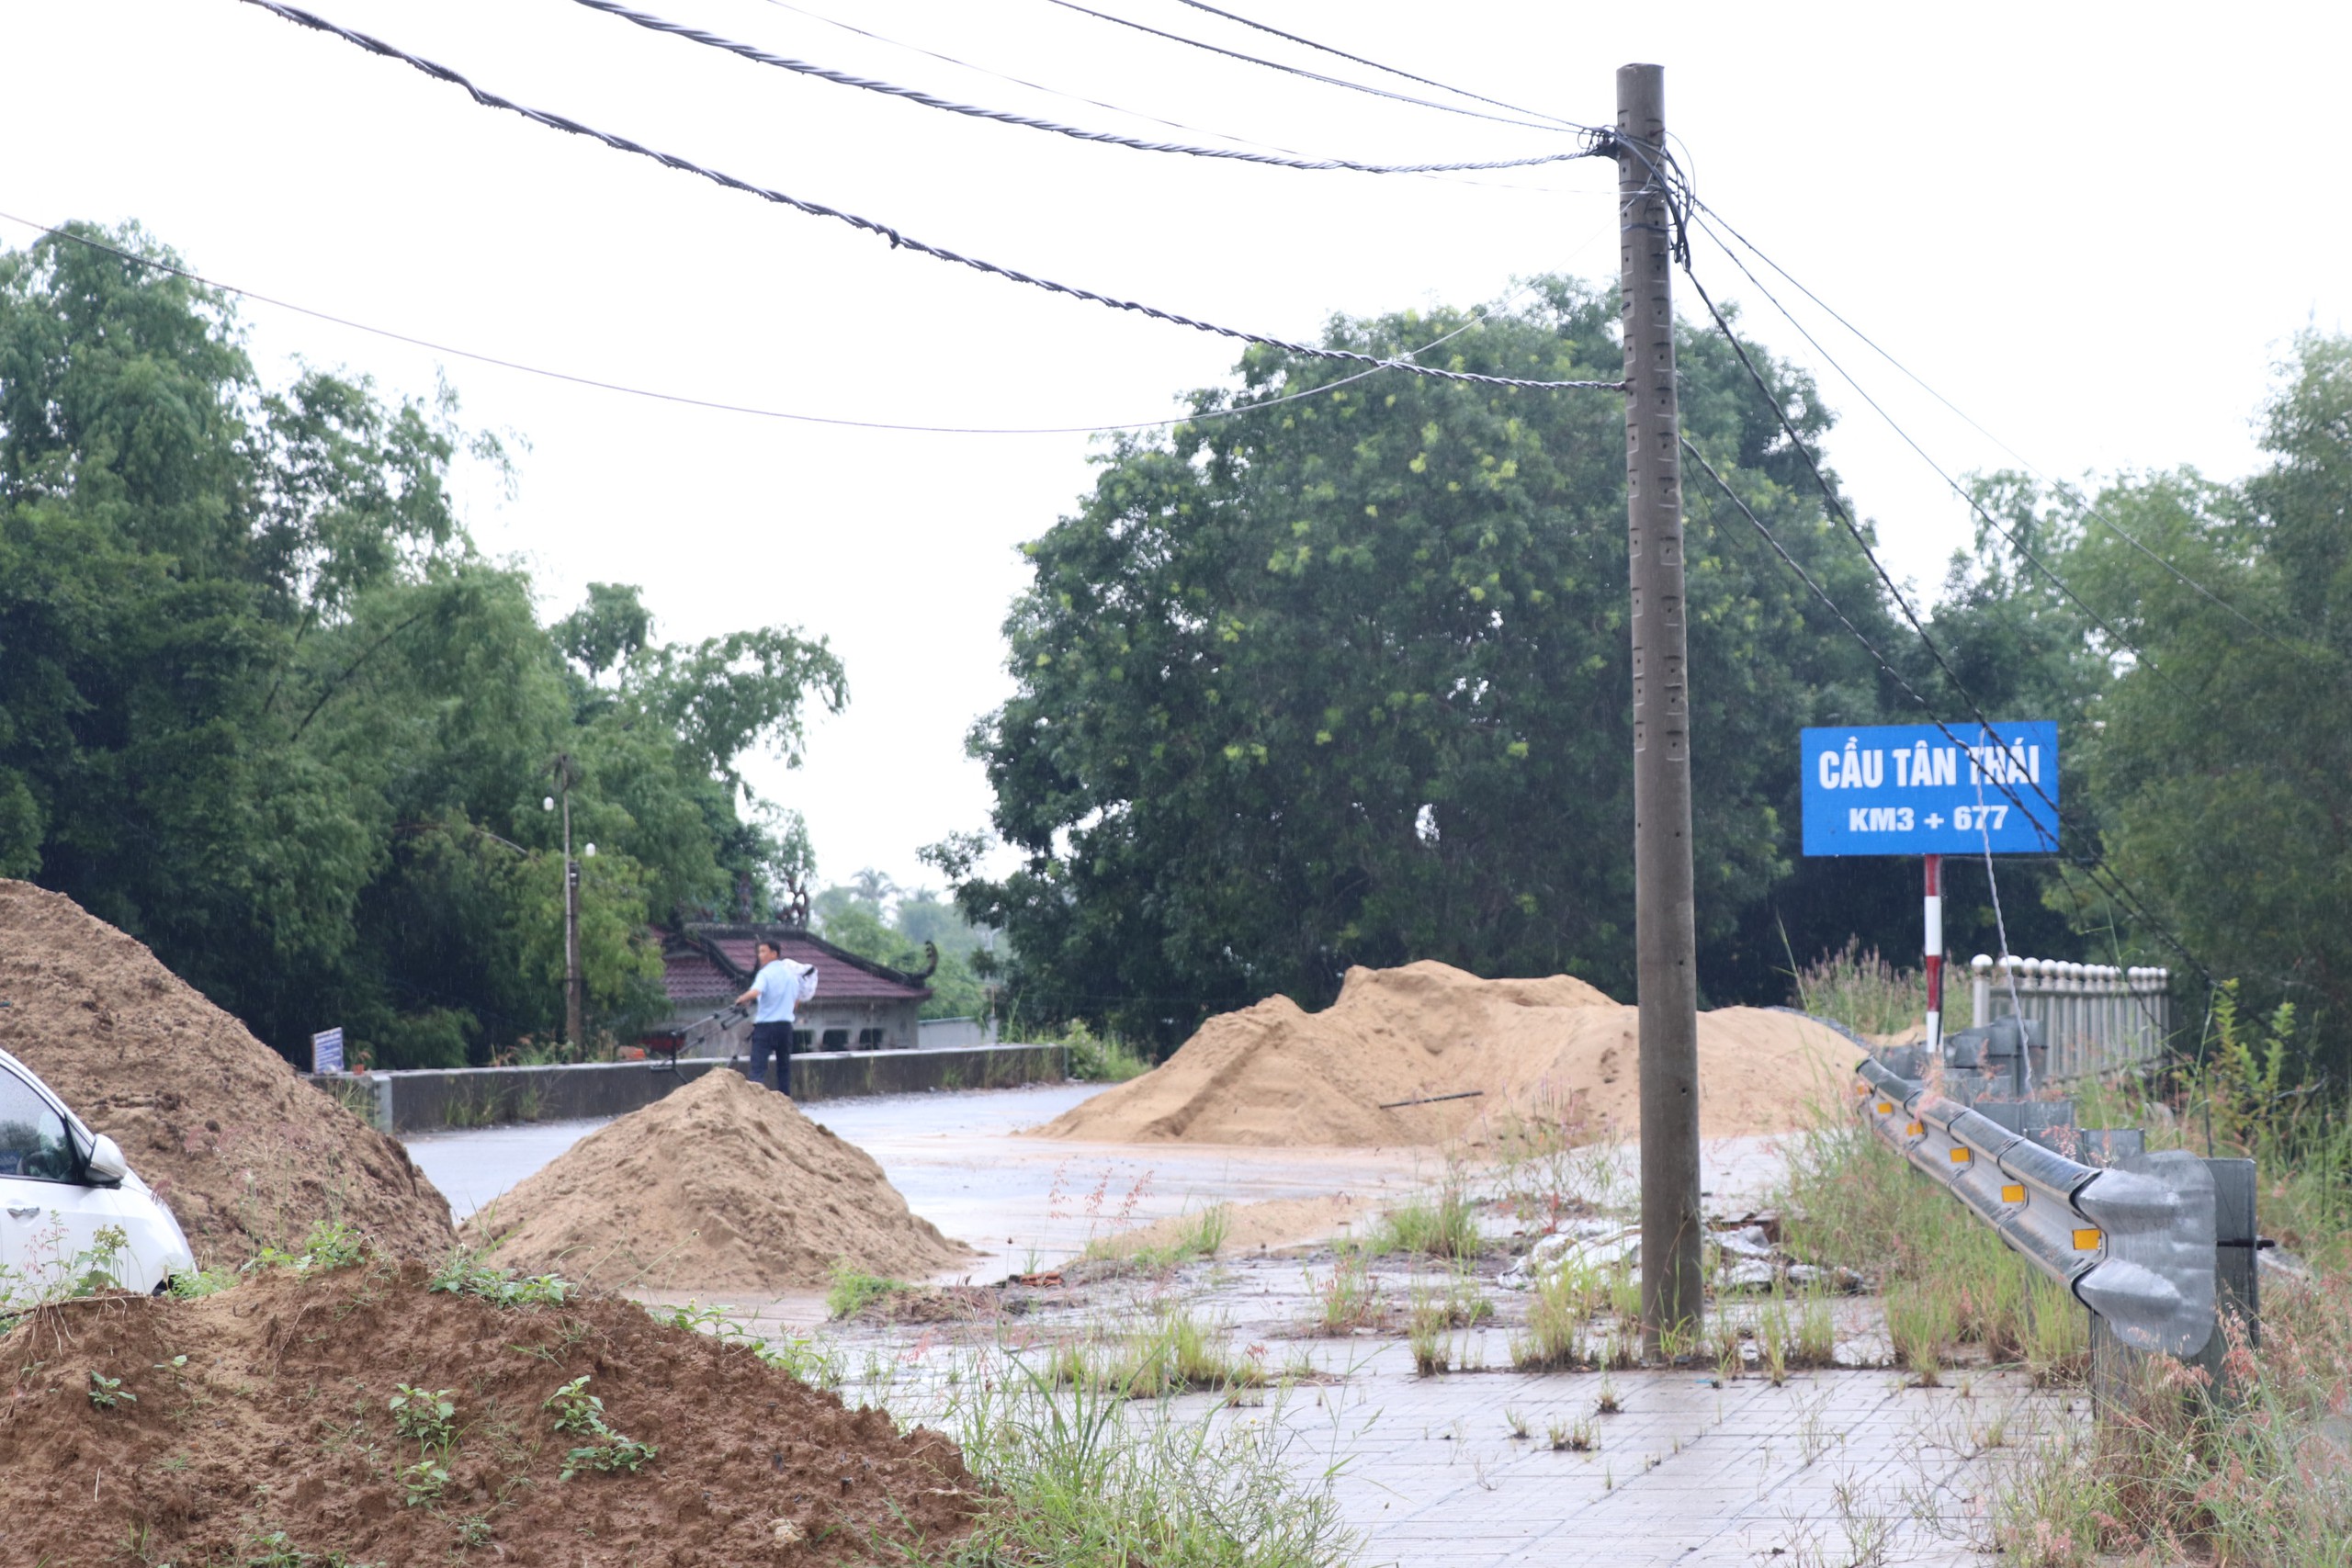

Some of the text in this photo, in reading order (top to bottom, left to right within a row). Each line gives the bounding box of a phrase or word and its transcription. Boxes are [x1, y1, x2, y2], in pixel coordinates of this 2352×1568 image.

[1819, 736, 2039, 789] CẦU TÂN THÁI
[1849, 806, 2008, 831] KM3 + 677
